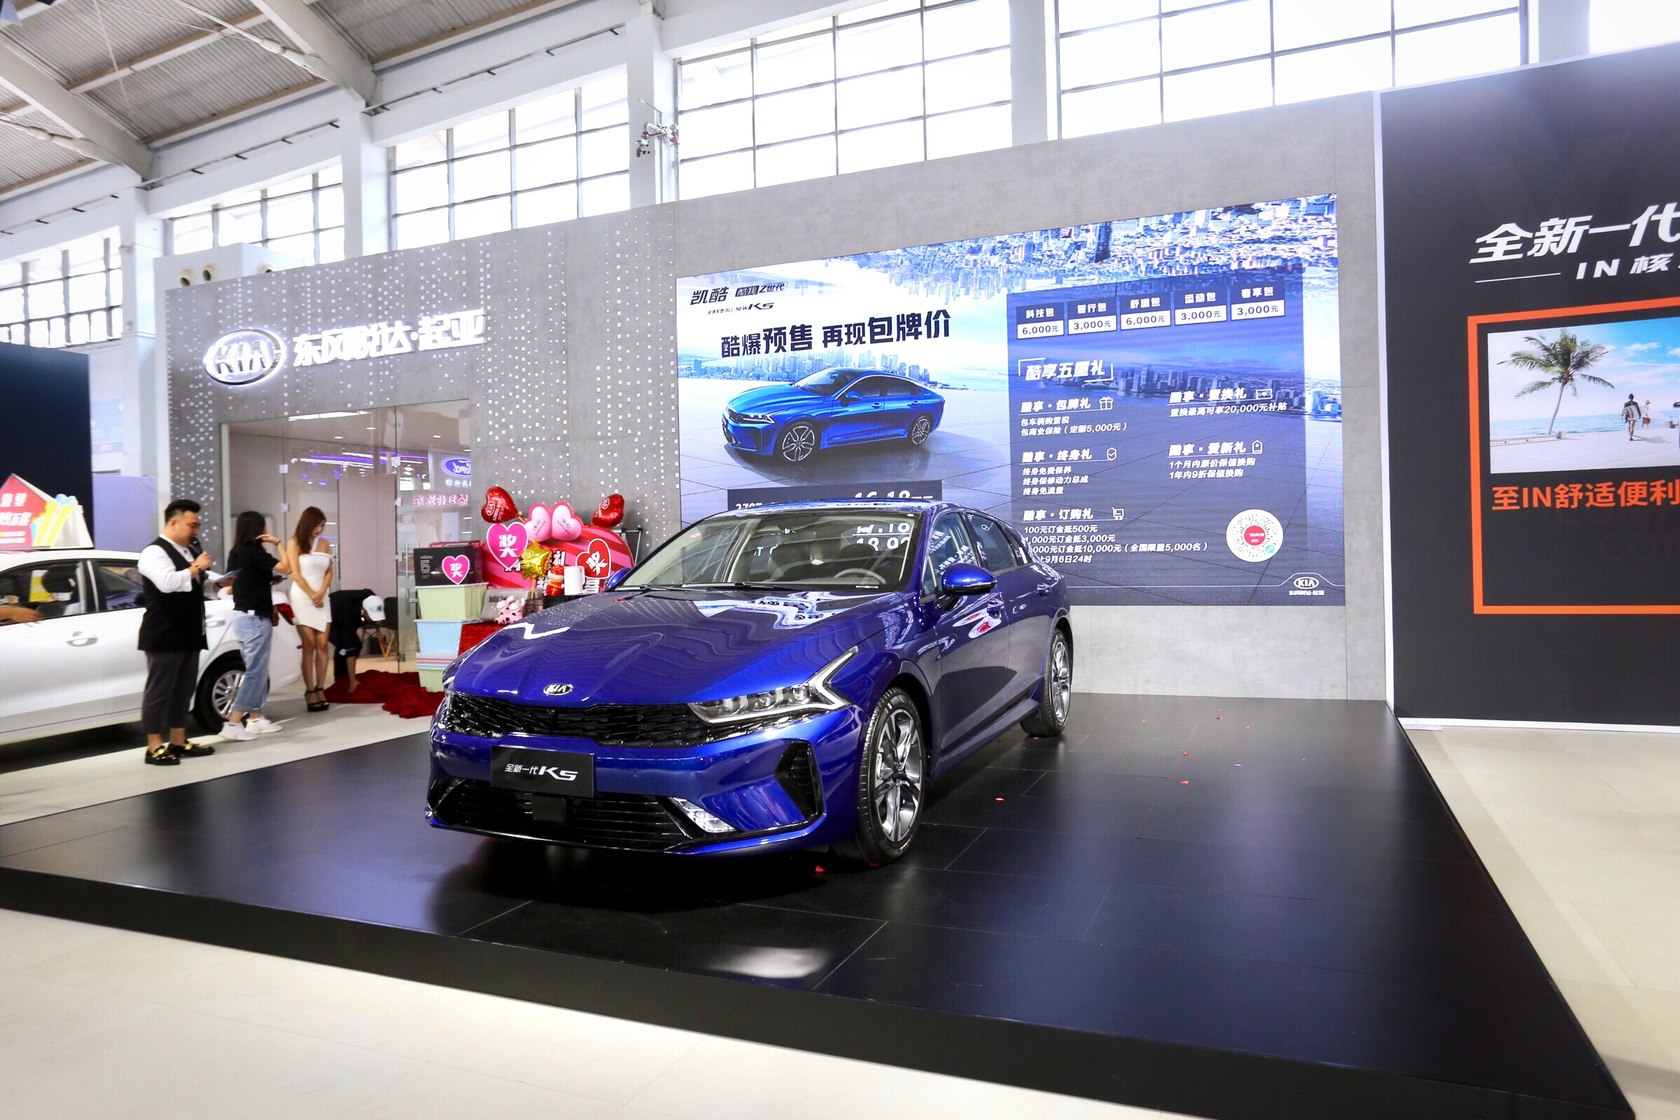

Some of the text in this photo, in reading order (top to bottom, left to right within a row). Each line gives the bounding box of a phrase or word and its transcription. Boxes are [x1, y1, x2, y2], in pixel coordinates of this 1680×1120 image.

[1469, 202, 1680, 264] 全新一代
[1575, 253, 1680, 280] IN 核
[690, 286, 729, 305] 凯酷
[1129, 297, 1161, 309] 舒适包
[1184, 292, 1217, 304] 运动包
[1025, 308, 1055, 319] 科技包
[1180, 309, 1221, 321] 3,000元
[1237, 304, 1279, 316] 3,000元
[1073, 320, 1111, 331] 3,000元
[1126, 315, 1165, 326] 6,000元
[293, 309, 487, 367] 东风悦达·起亚
[721, 309, 951, 358] 酷爆预售 再现包牌价
[1022, 324, 1059, 336] 6,000元
[1025, 359, 1105, 381] 酷享五重礼
[1492, 478, 1680, 511] 至IN舒适便利
[1024, 524, 1098, 534] 100元订金抵500元
[499, 534, 517, 557] 奖
[449, 562, 463, 578] 奖
[585, 551, 608, 576] 奖
